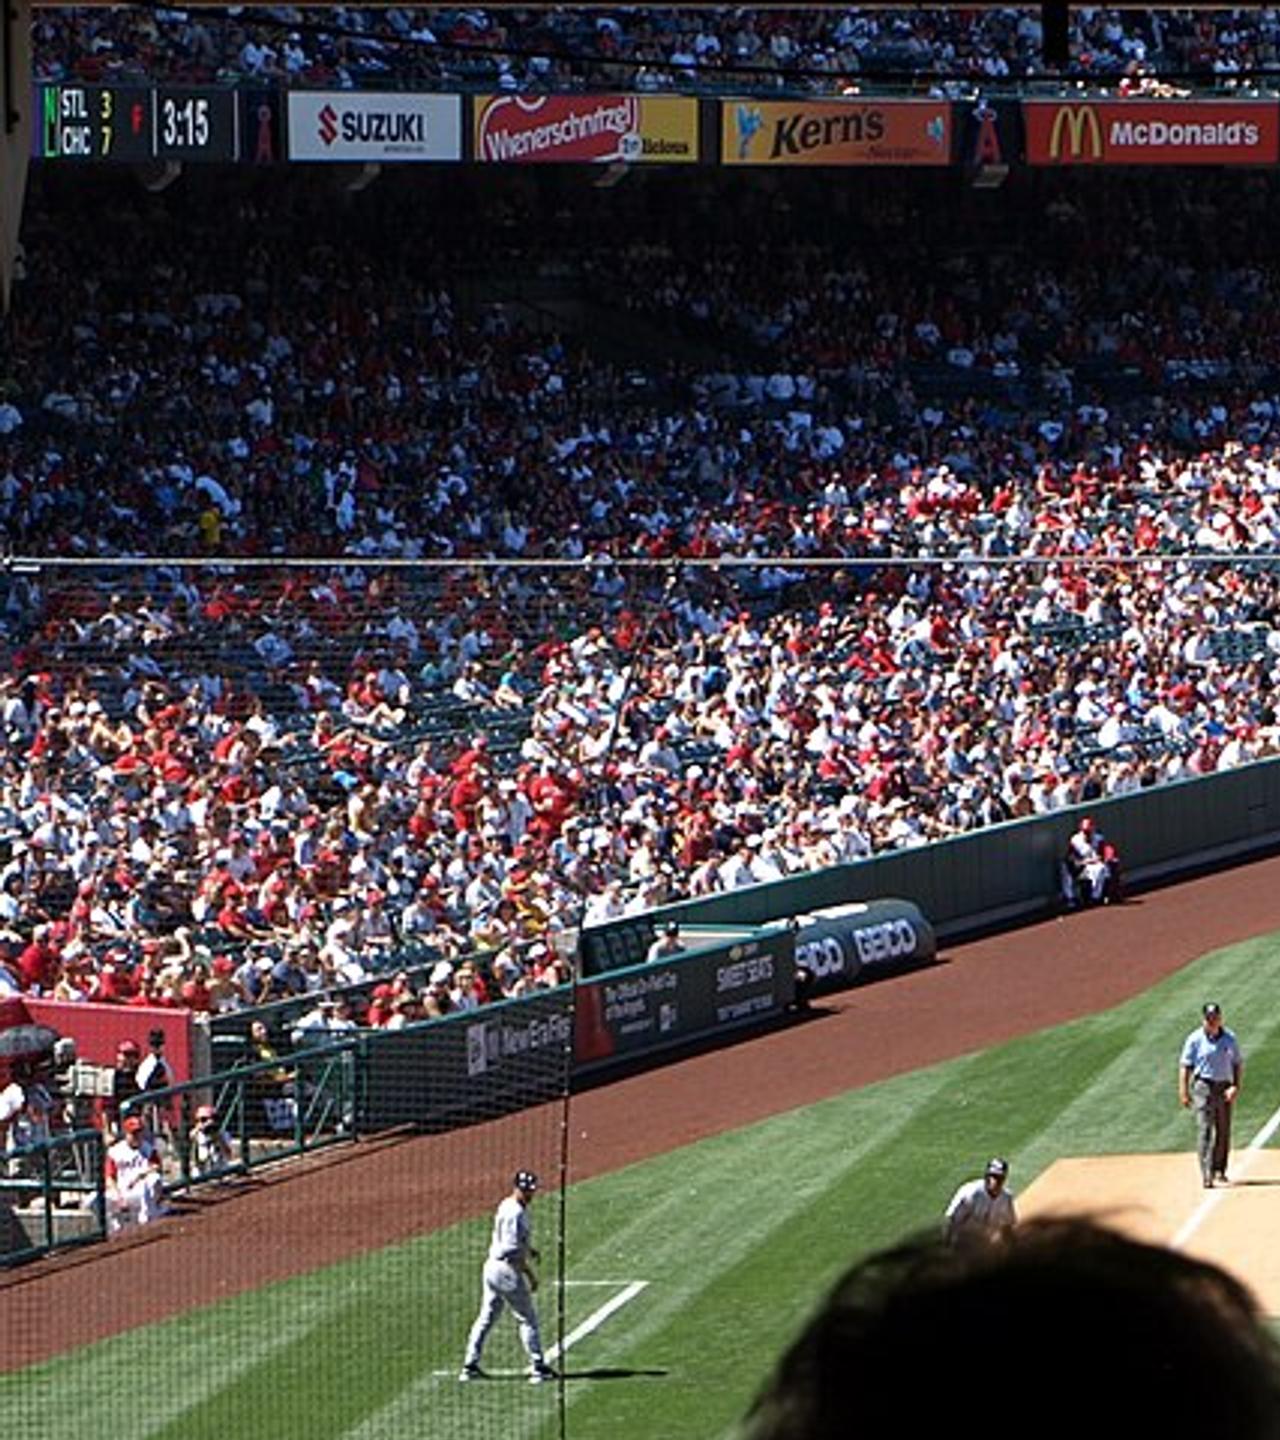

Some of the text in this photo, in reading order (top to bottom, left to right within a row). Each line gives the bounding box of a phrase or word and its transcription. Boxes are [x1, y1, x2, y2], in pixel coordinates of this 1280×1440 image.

[62, 89, 112, 119] STL 3
[163, 99, 209, 146] 3:15
[62, 125, 112, 156] CHC 7
[342, 111, 424, 142] SUZUKI
[486, 97, 632, 161] Wienerschnitzel
[770, 107, 885, 159] Kern's
[1109, 121, 1260, 146] McDonald's
[853, 918, 917, 965] GEICO
